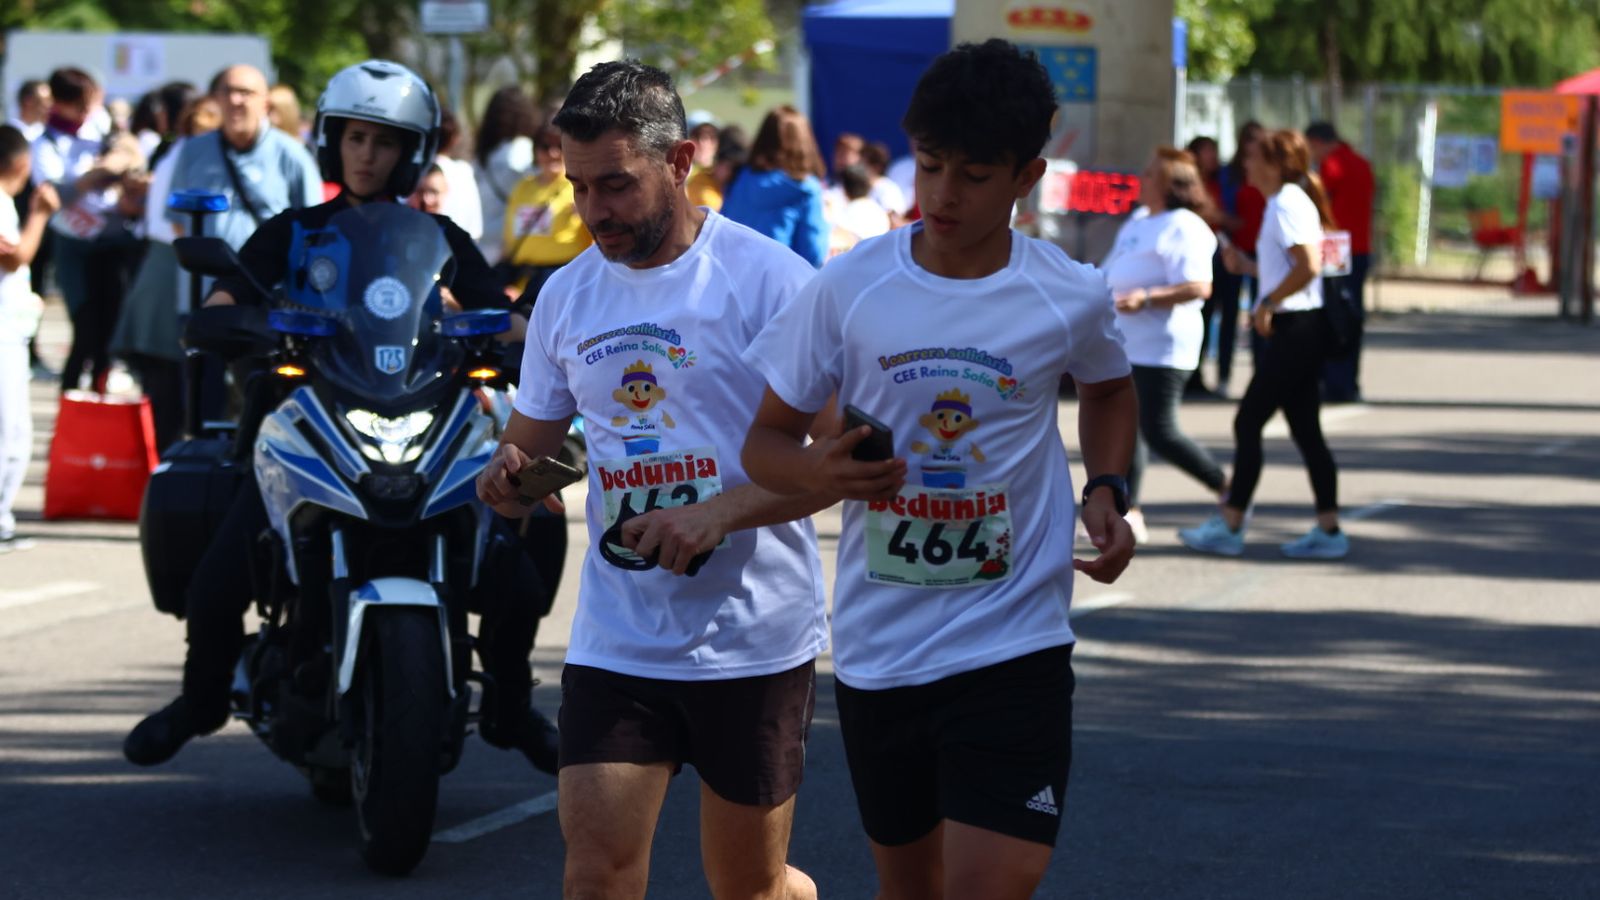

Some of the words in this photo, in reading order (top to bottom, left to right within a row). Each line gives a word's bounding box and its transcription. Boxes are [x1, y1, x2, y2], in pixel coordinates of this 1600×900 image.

[584, 327, 626, 350] carrera
[585, 348, 604, 365] CEE
[605, 342, 639, 356] Reina
[889, 348, 945, 367] carrera
[893, 368, 918, 384] CEE
[920, 366, 959, 378] Reina
[598, 454, 717, 492] bedunia
[888, 520, 989, 565] 464
[1026, 800, 1058, 816] adidas
